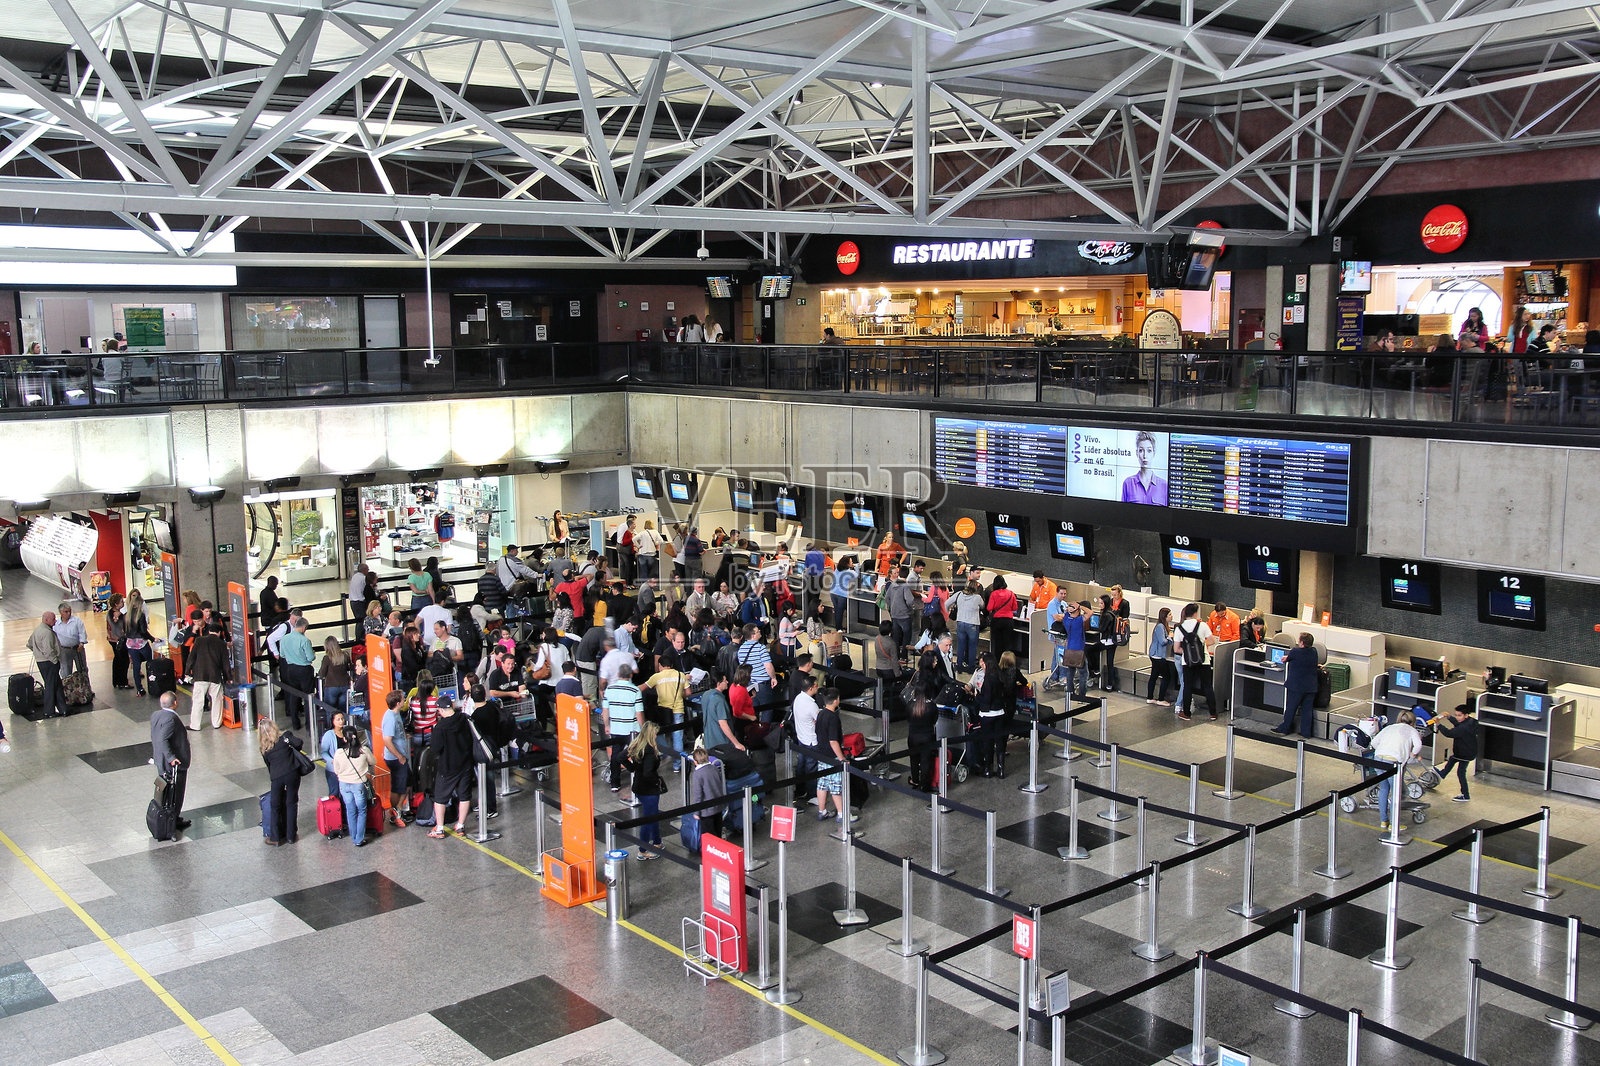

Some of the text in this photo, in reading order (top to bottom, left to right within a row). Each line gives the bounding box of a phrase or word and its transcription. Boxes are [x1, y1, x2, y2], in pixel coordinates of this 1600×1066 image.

[1422, 220, 1464, 237] Coca-Cola
[893, 239, 1033, 264] RESTAURANTE
[984, 421, 1027, 429] Departures
[1084, 435, 1101, 443] Vivo.
[1237, 438, 1279, 446] Partidas
[1071, 433, 1081, 464] vivo
[1103, 447, 1131, 456] absoluta
[1096, 457, 1104, 465] 4G
[672, 473, 681, 481] 02
[1094, 468, 1115, 477] Brasil.
[736, 481, 745, 489] 03
[779, 487, 788, 495] 04
[855, 497, 865, 505] 05
[906, 503, 917, 511] 06
[998, 514, 1010, 523] 07
[1061, 521, 1074, 531] 08
[1175, 535, 1190, 546] 09
[1255, 545, 1270, 556] 10
[1401, 563, 1418, 576] 11
[1500, 576, 1520, 589] 12
